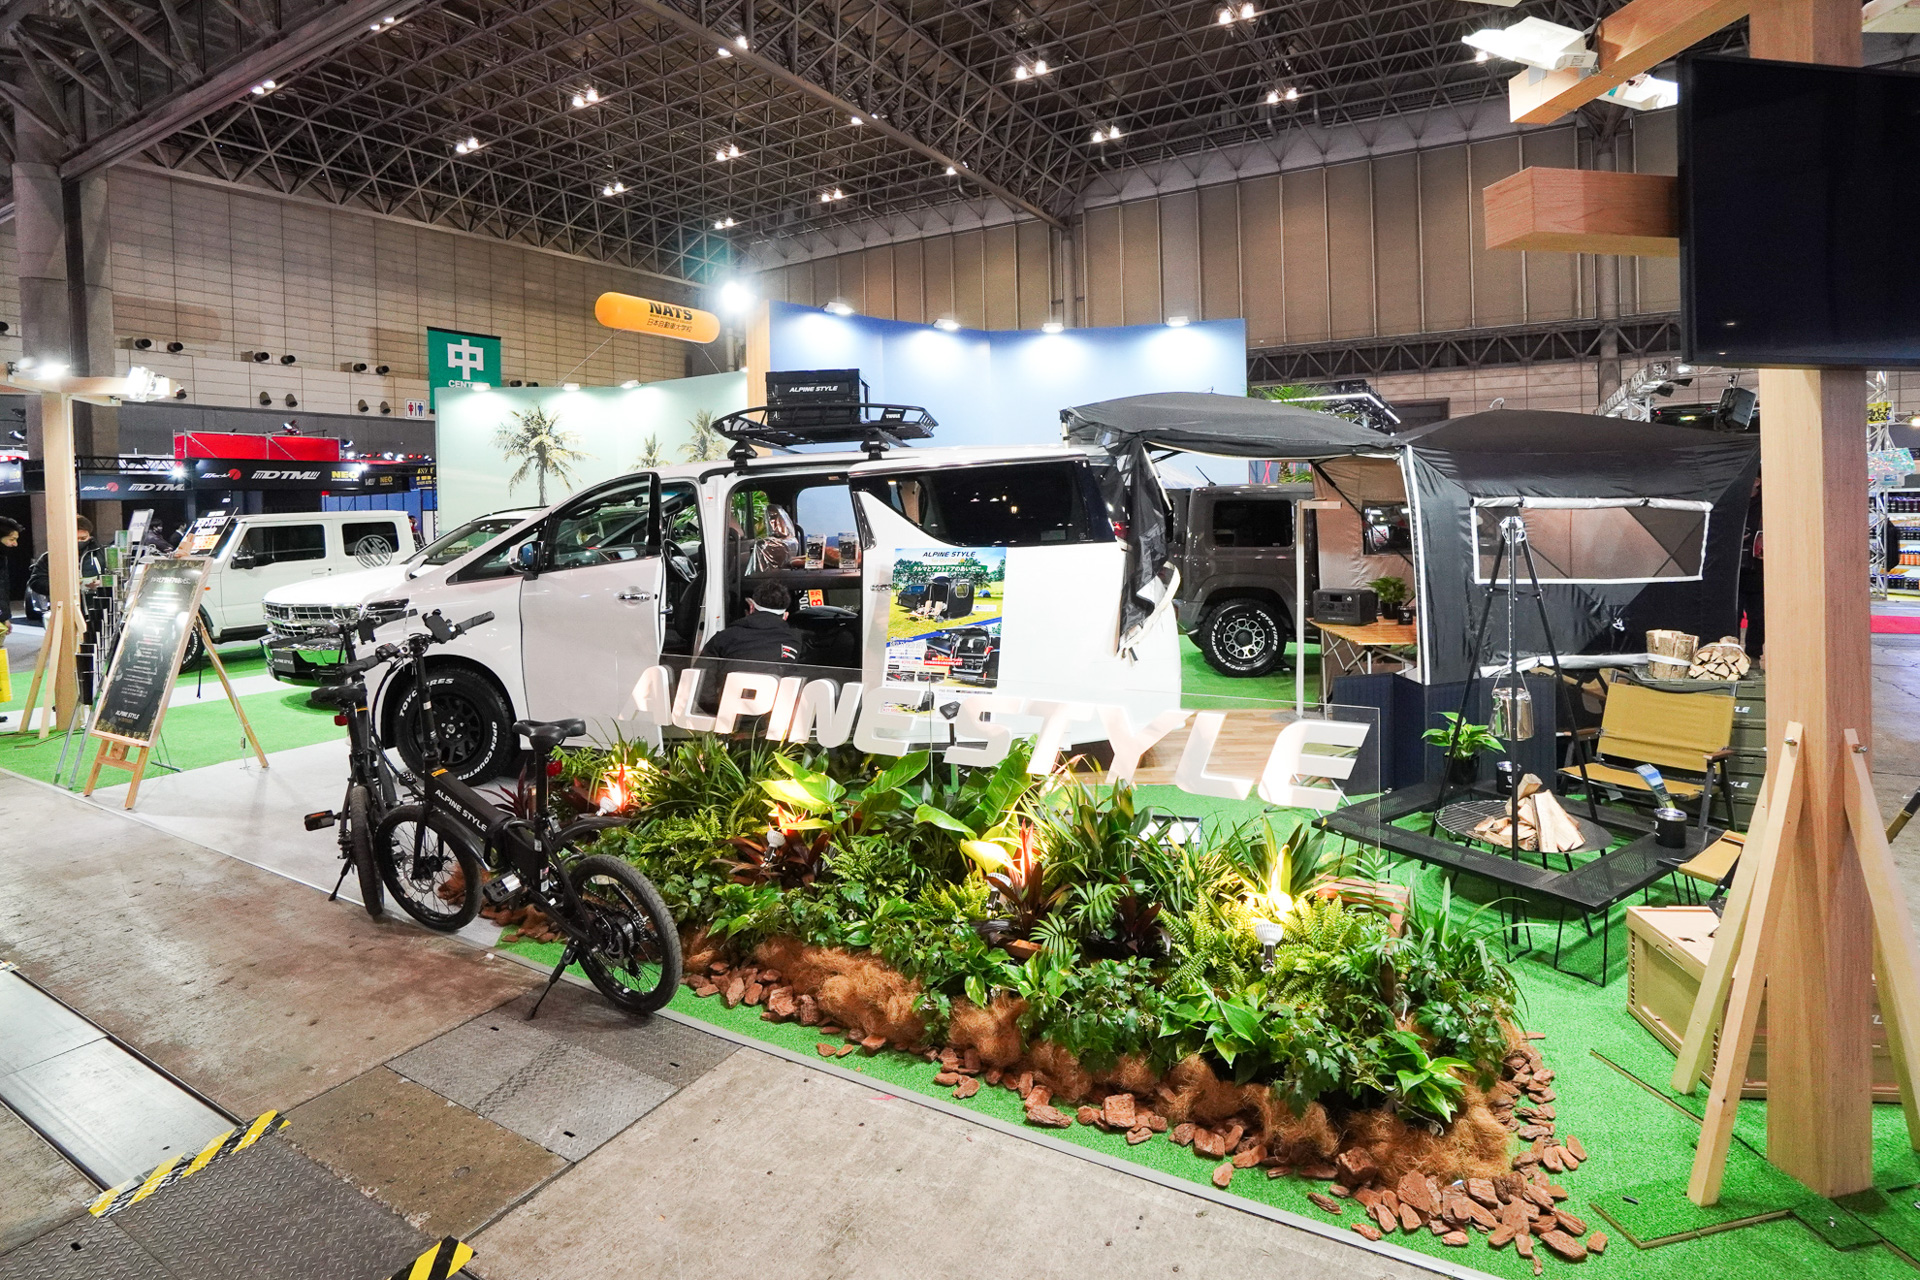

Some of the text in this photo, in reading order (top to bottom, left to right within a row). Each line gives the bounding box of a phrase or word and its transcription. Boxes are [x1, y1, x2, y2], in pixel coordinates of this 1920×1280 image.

[648, 301, 693, 321] NATS
[646, 318, 693, 333] 日本自動車大学校
[446, 338, 484, 381] 中
[379, 475, 393, 483] NEO
[1255, 609, 1275, 627] TOYO
[617, 664, 1371, 812] ALPINE STYLE
[434, 788, 488, 832] ALPINE STYLE
